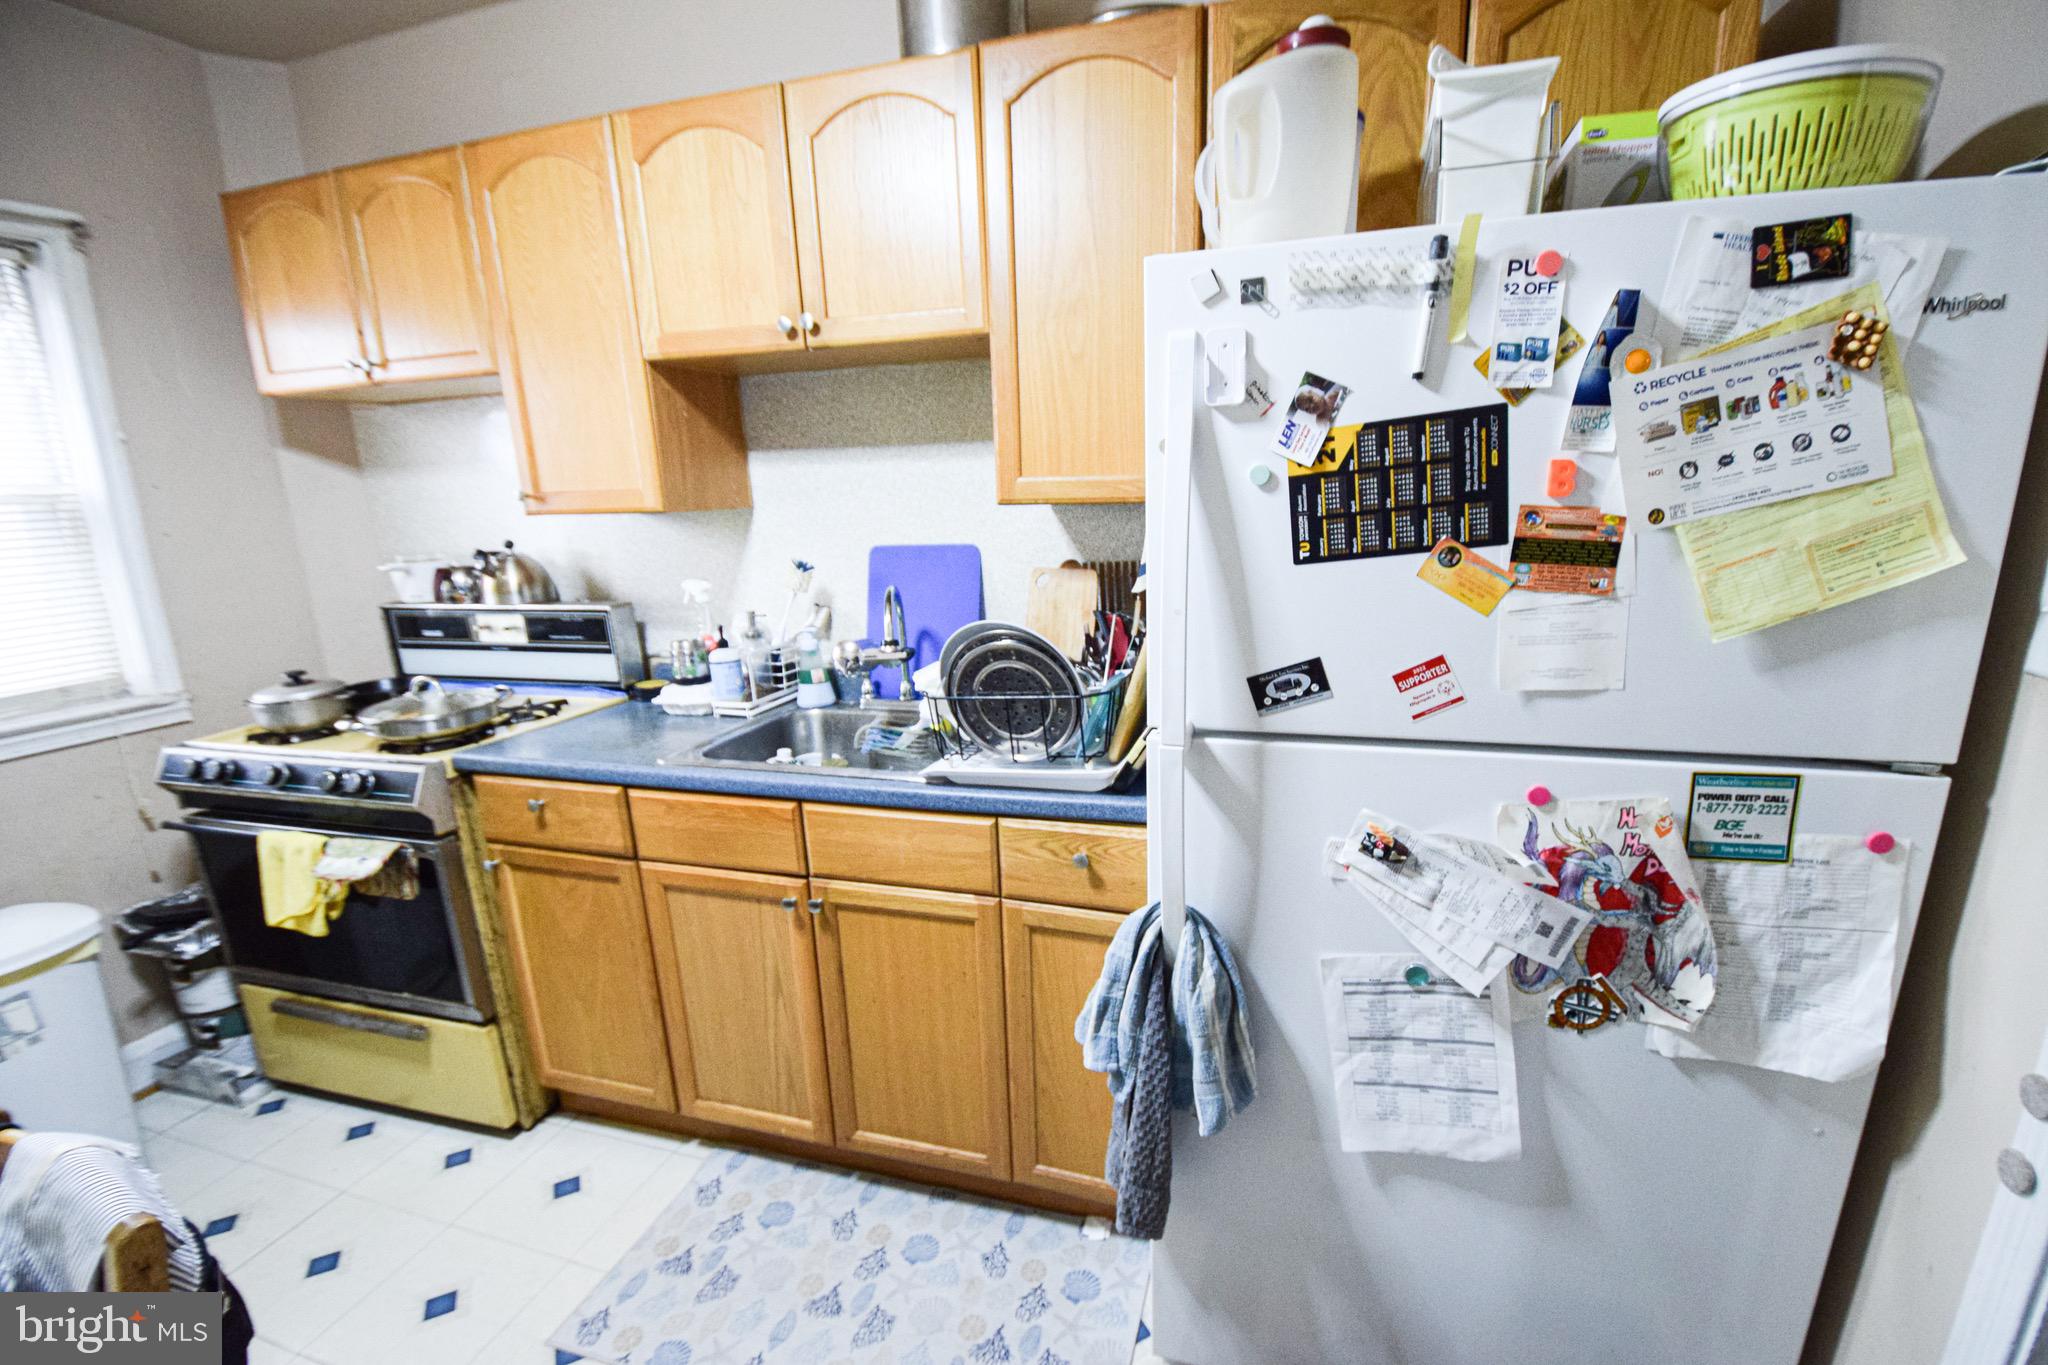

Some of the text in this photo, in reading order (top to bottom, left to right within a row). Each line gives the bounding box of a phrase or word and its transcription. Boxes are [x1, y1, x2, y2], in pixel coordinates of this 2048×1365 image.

[1504, 281, 1559, 295] $2 OFF
[1922, 293, 2007, 316] Whirlpool
[1650, 366, 1707, 390] RECYCLE
[1278, 419, 1297, 449] LEN
[1299, 541, 1310, 560] TU
[1398, 664, 1448, 691] SUPPORTER
[1698, 792, 1732, 801] POWER
[1735, 794, 1761, 802] OUT?
[1696, 802, 1788, 816] 1-877-778-2222
[1714, 820, 1746, 830] BGE
